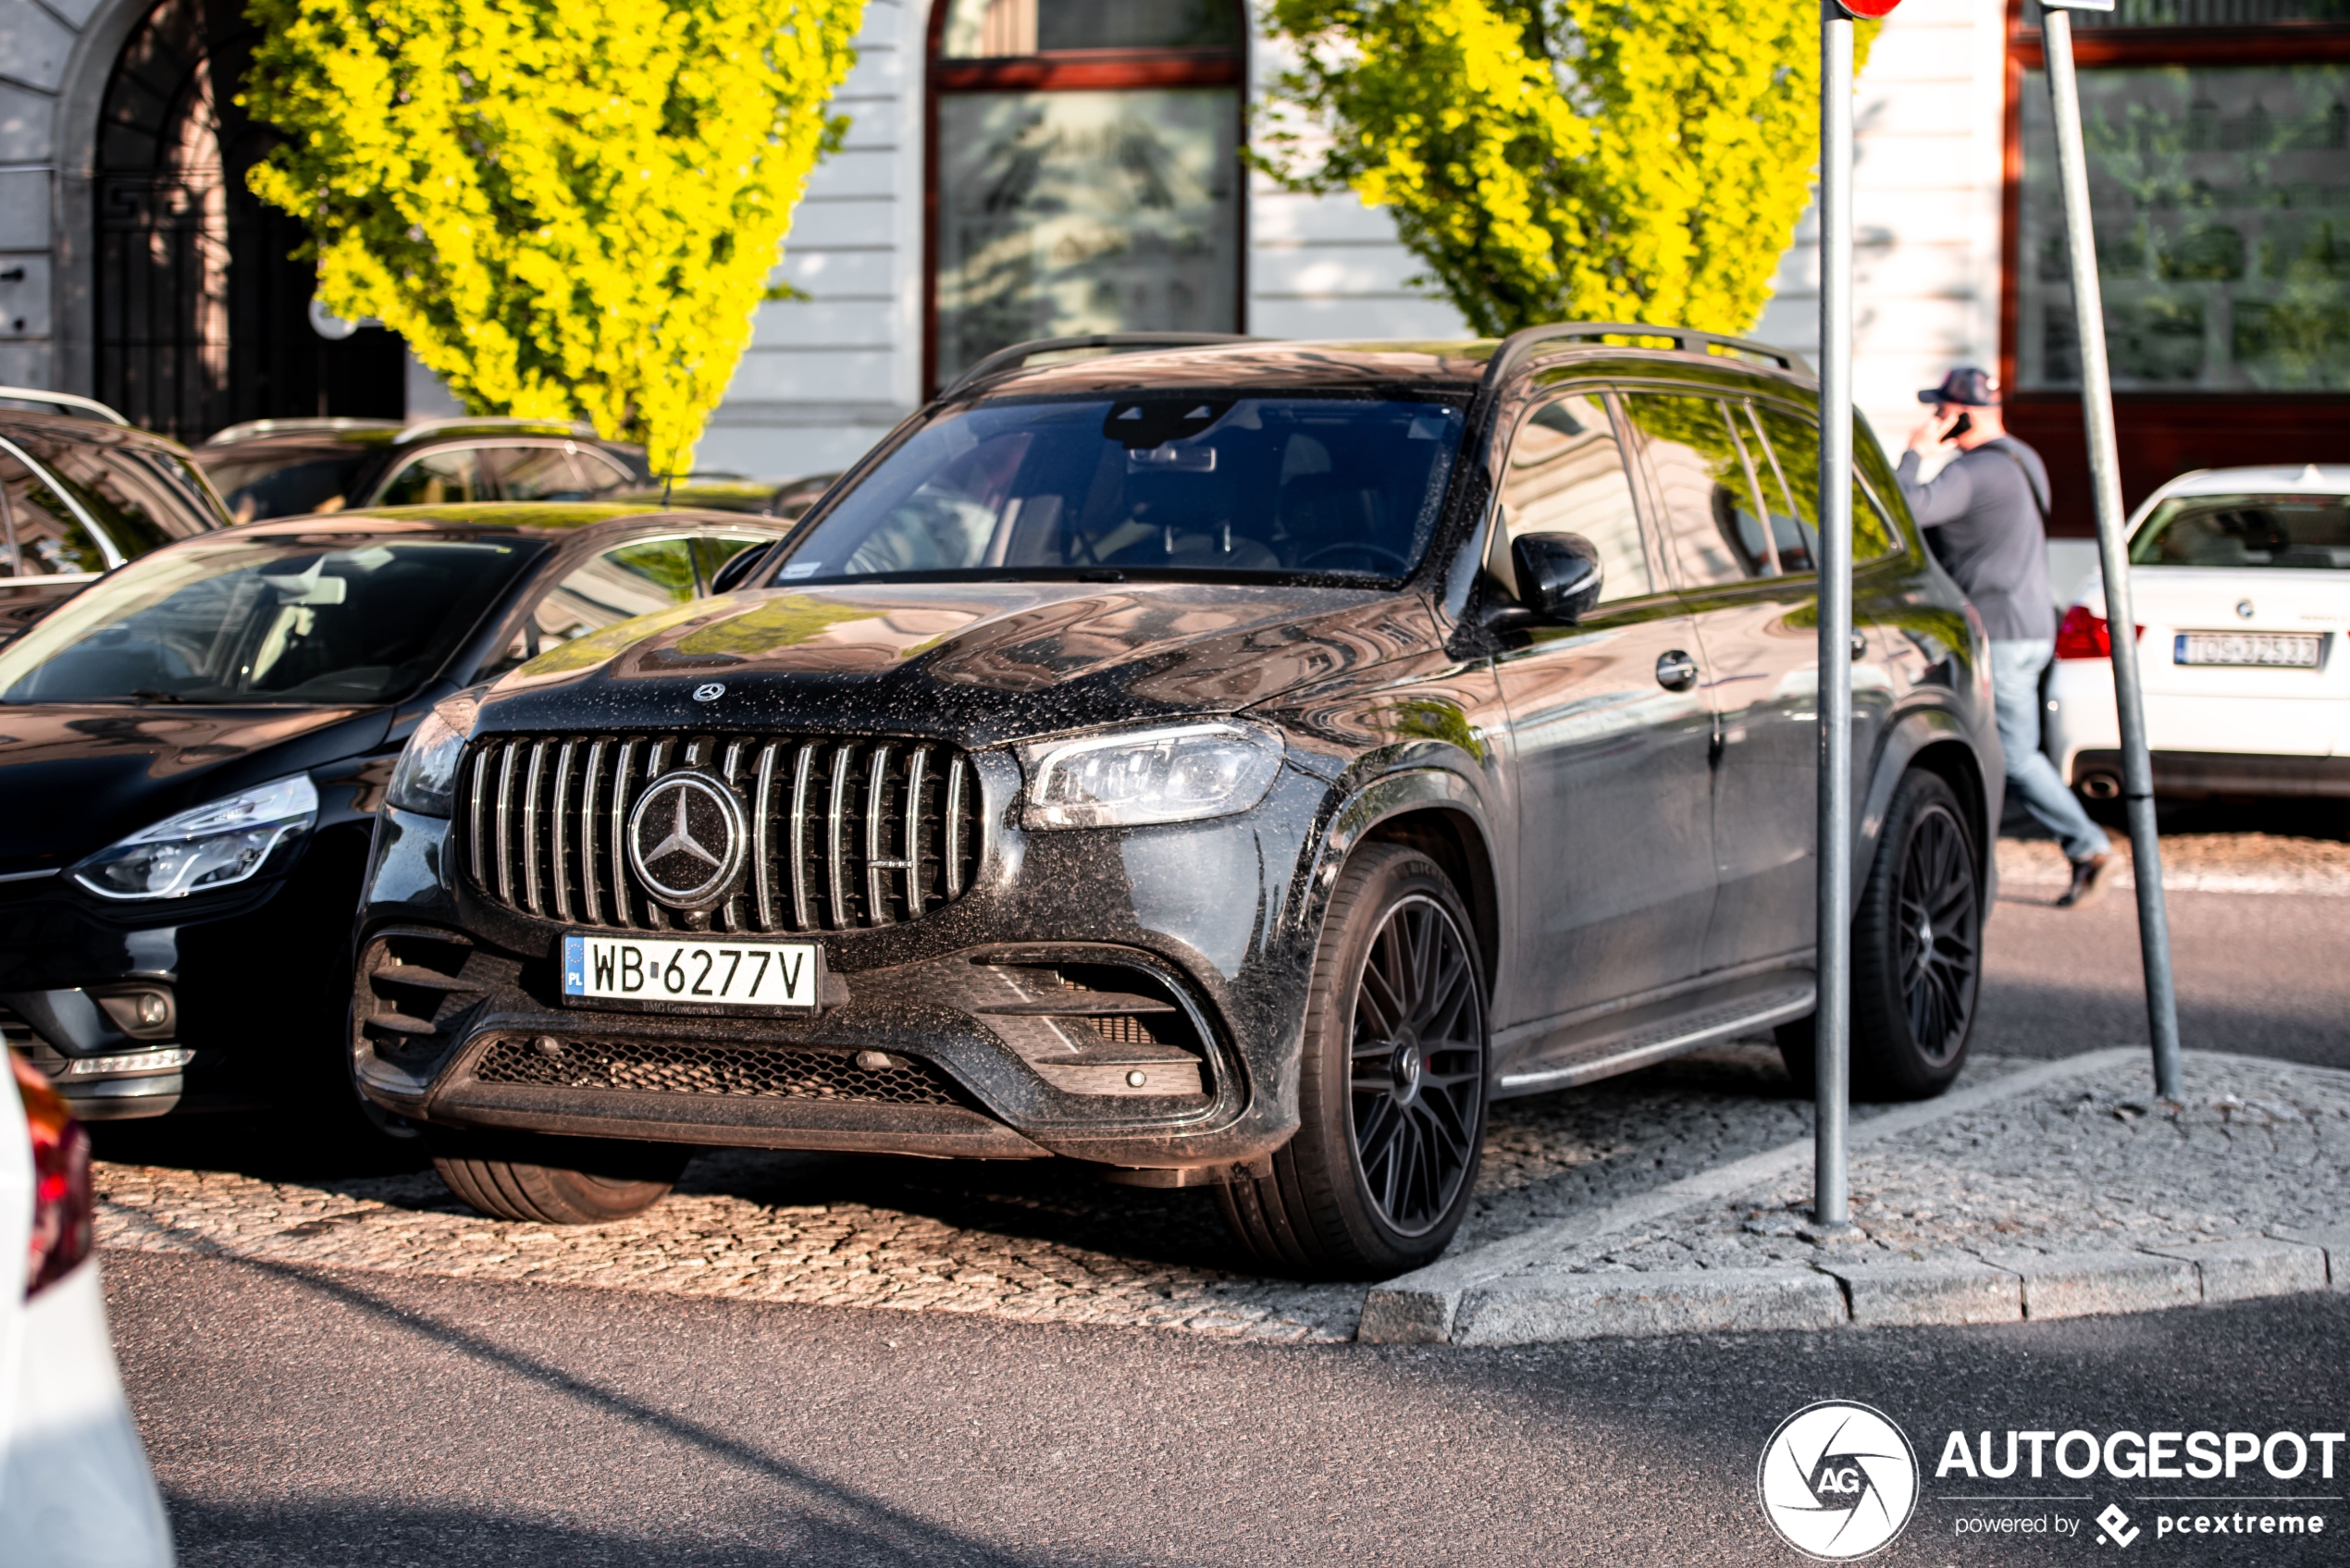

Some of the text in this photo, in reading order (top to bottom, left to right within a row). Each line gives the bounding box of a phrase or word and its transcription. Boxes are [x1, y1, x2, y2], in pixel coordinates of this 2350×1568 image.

[568, 971, 584, 986] PL
[593, 944, 804, 999] WB 6277V
